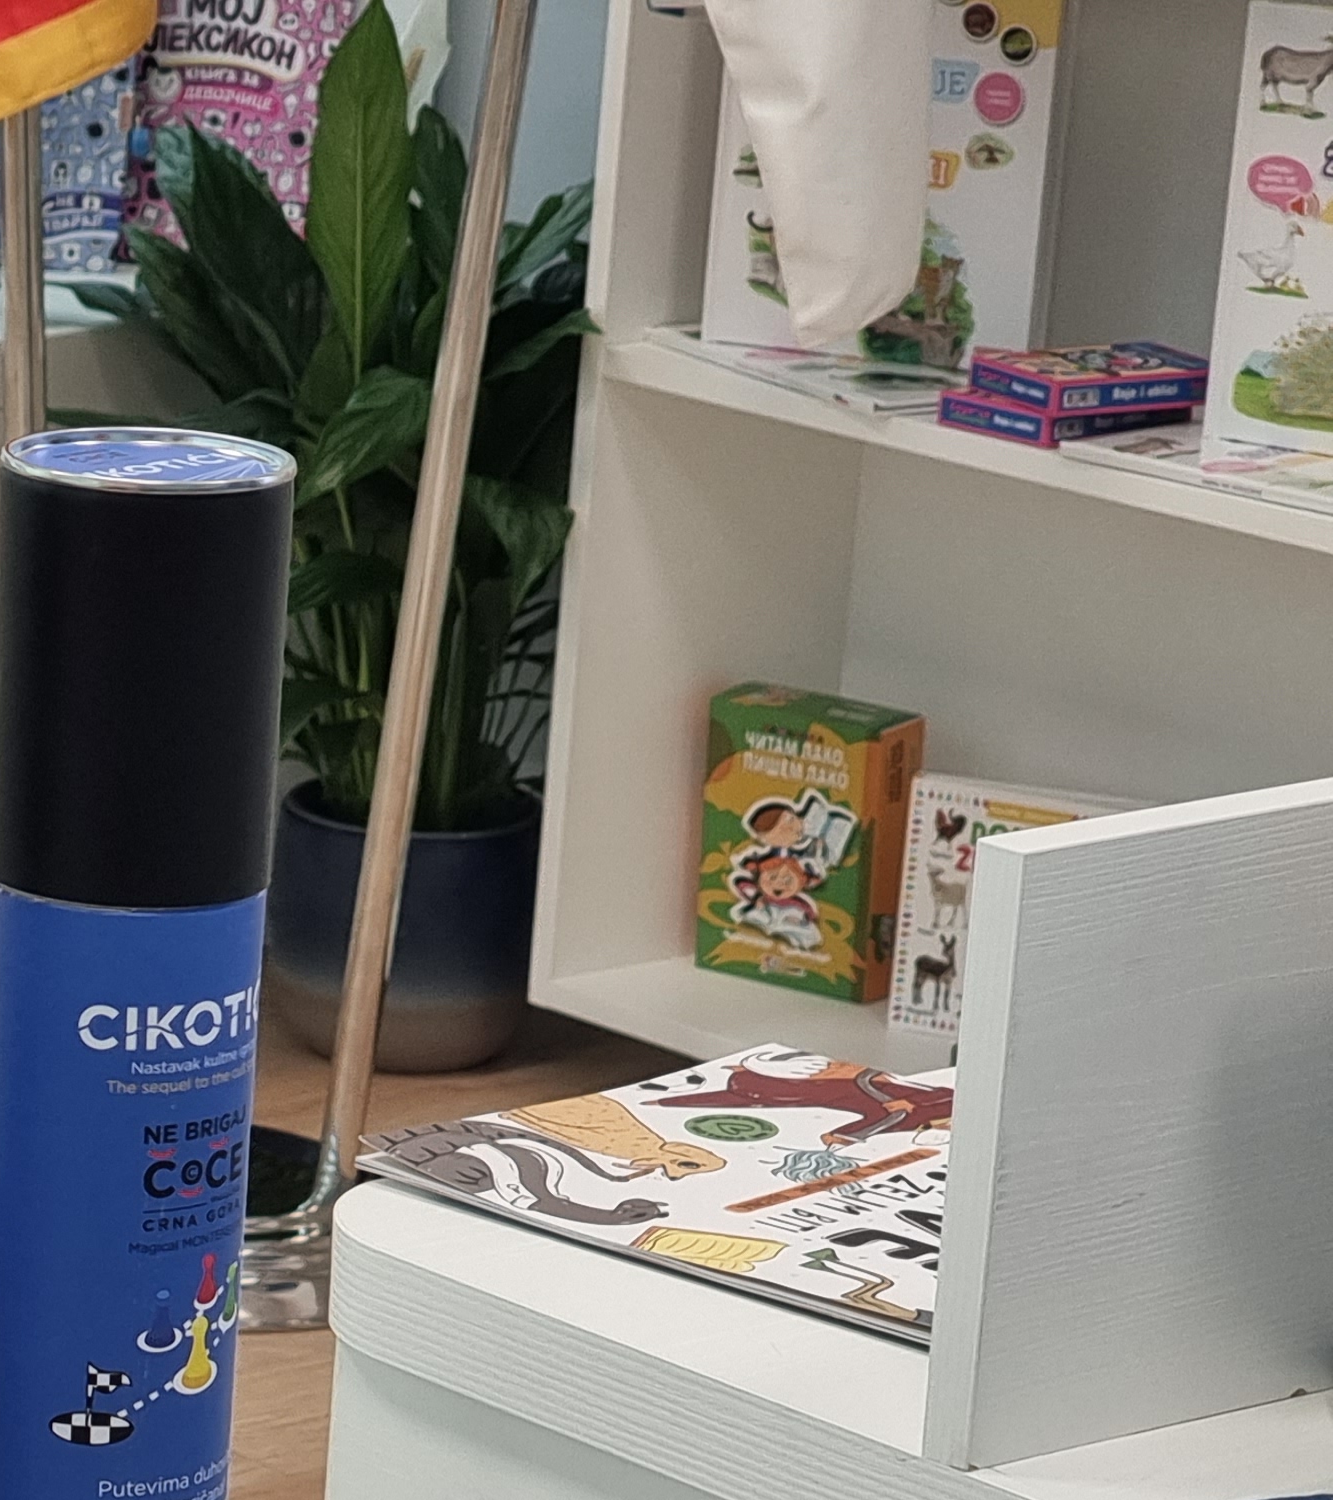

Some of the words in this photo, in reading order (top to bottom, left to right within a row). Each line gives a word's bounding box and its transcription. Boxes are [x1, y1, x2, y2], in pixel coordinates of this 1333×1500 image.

[144, 23, 296, 70] ЛЕКСИКОН
[131, 1058, 200, 1075] Nastavak
[107, 1079, 137, 1094] The
[142, 1077, 191, 1095] sequel
[195, 1076, 209, 1089] to
[143, 1124, 179, 1145] NE
[185, 1104, 246, 1141] BRIGAJ
[142, 1216, 197, 1232] CRNA
[206, 1199, 240, 1222] GORA
[98, 1475, 189, 1498] Putevima
